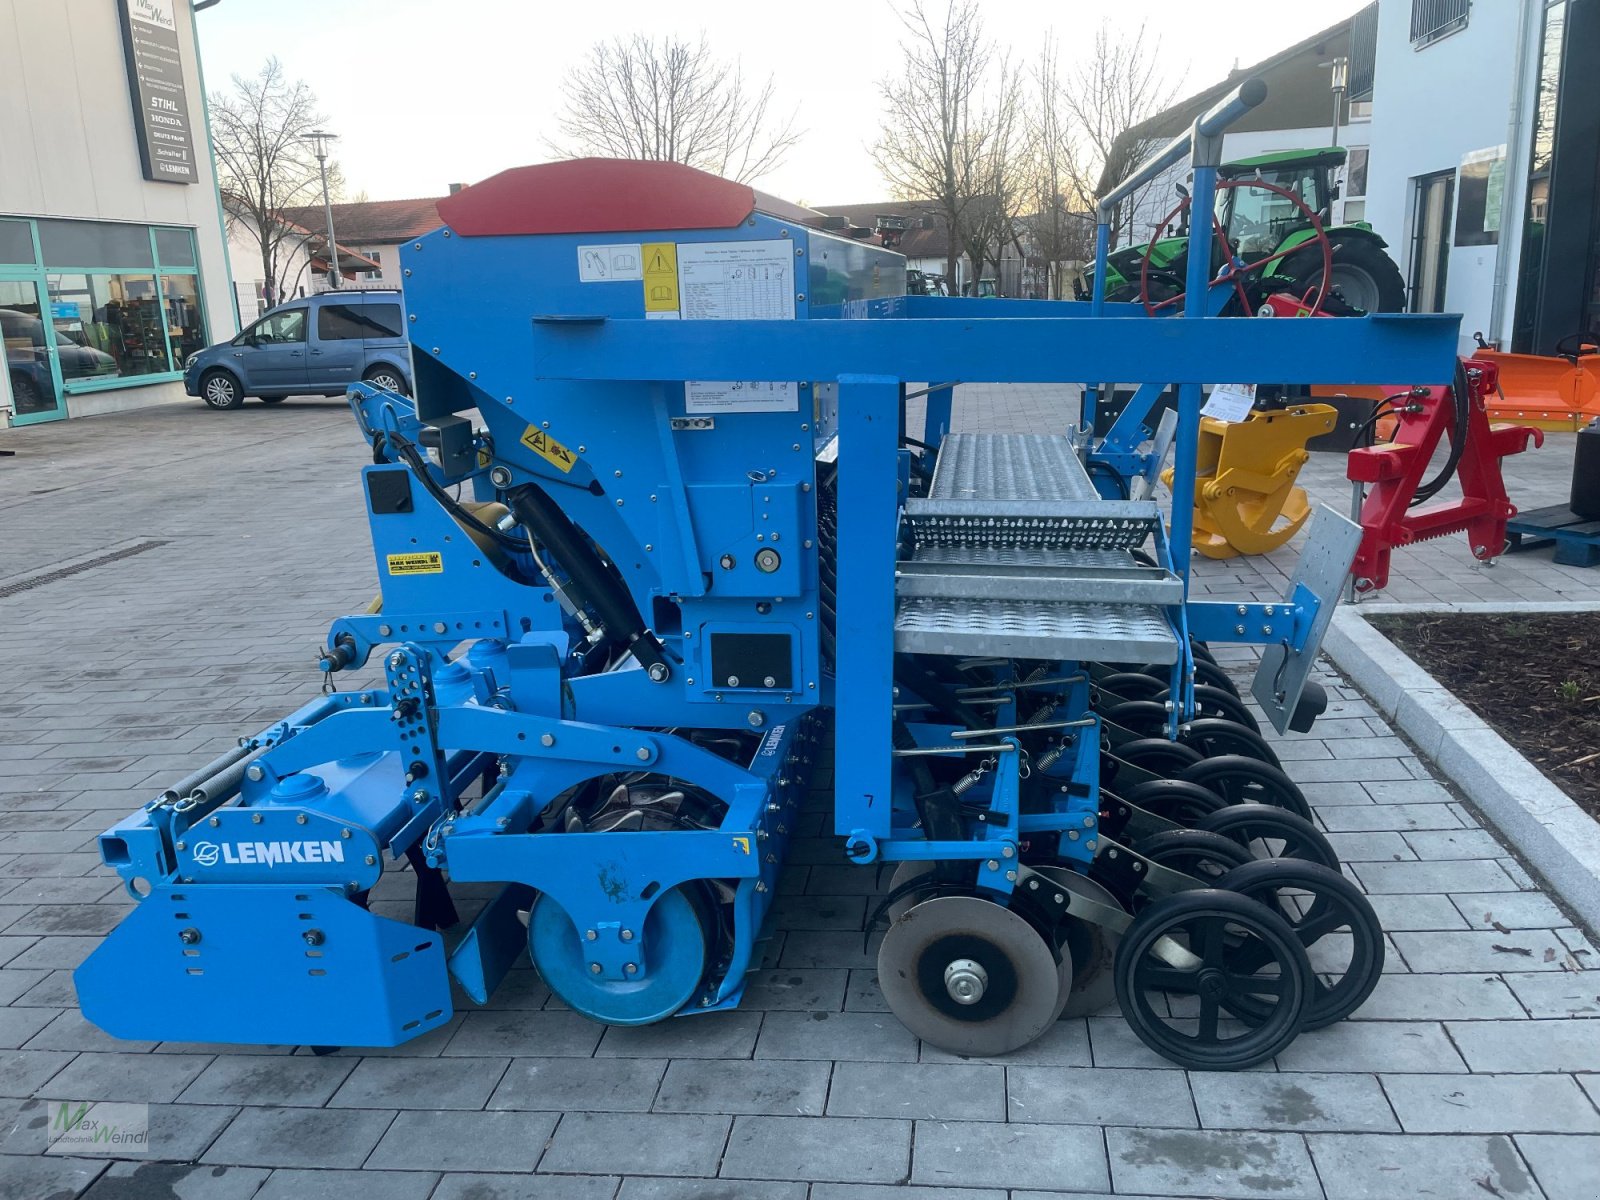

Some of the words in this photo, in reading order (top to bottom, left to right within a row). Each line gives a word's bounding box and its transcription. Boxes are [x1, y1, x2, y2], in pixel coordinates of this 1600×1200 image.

[151, 96, 178, 111] STIHL
[151, 114, 182, 126] HONDA
[165, 164, 190, 175] LEMKEN
[221, 840, 345, 869] LEMKEN
